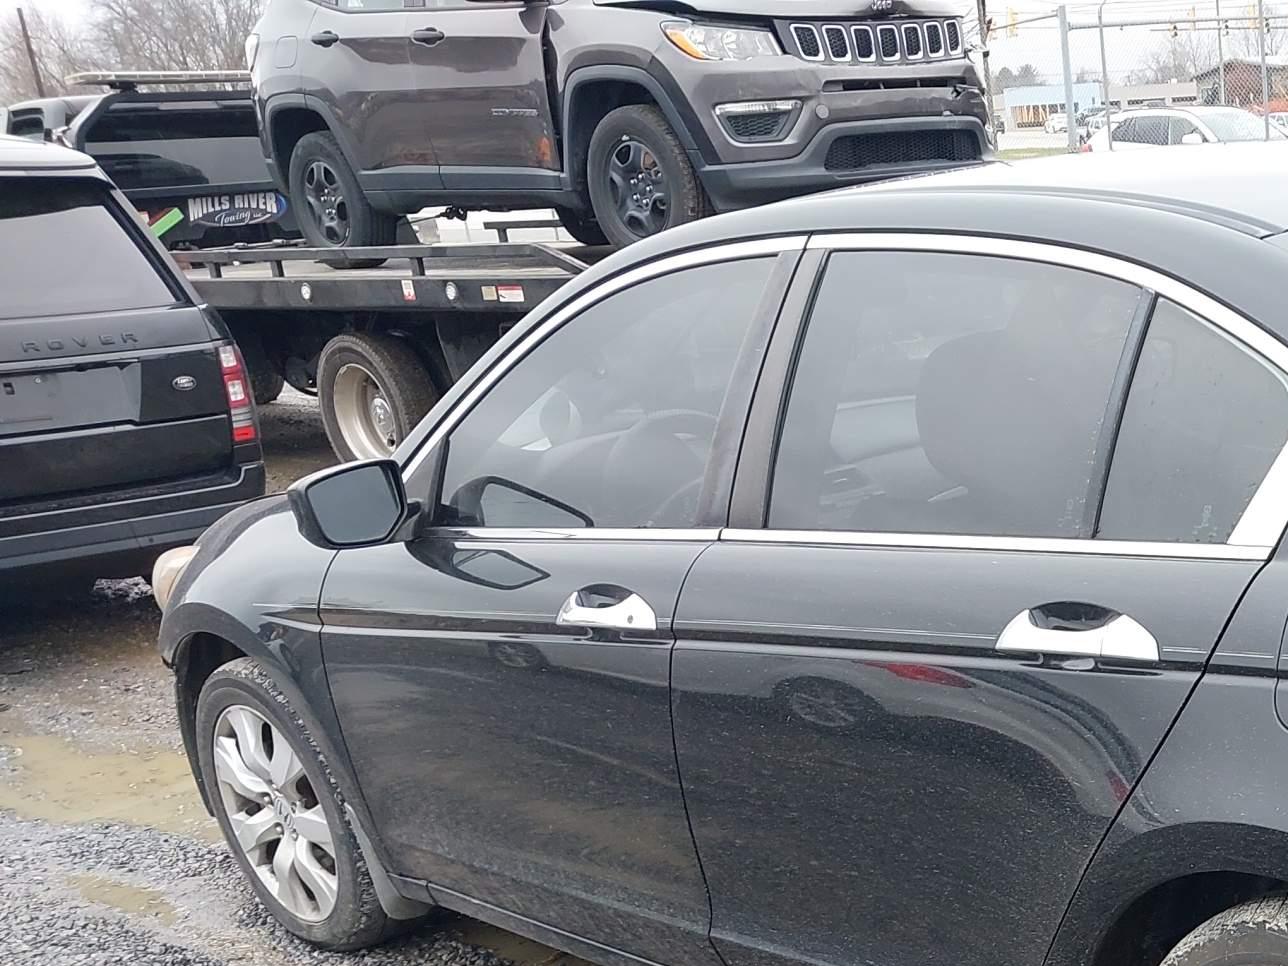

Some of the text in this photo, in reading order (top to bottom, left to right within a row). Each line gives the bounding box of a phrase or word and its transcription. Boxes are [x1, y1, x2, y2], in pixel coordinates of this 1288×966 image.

[188, 192, 277, 221] MILLS RIVER
[215, 210, 251, 227] Towing
[21, 332, 139, 353] ROVER
